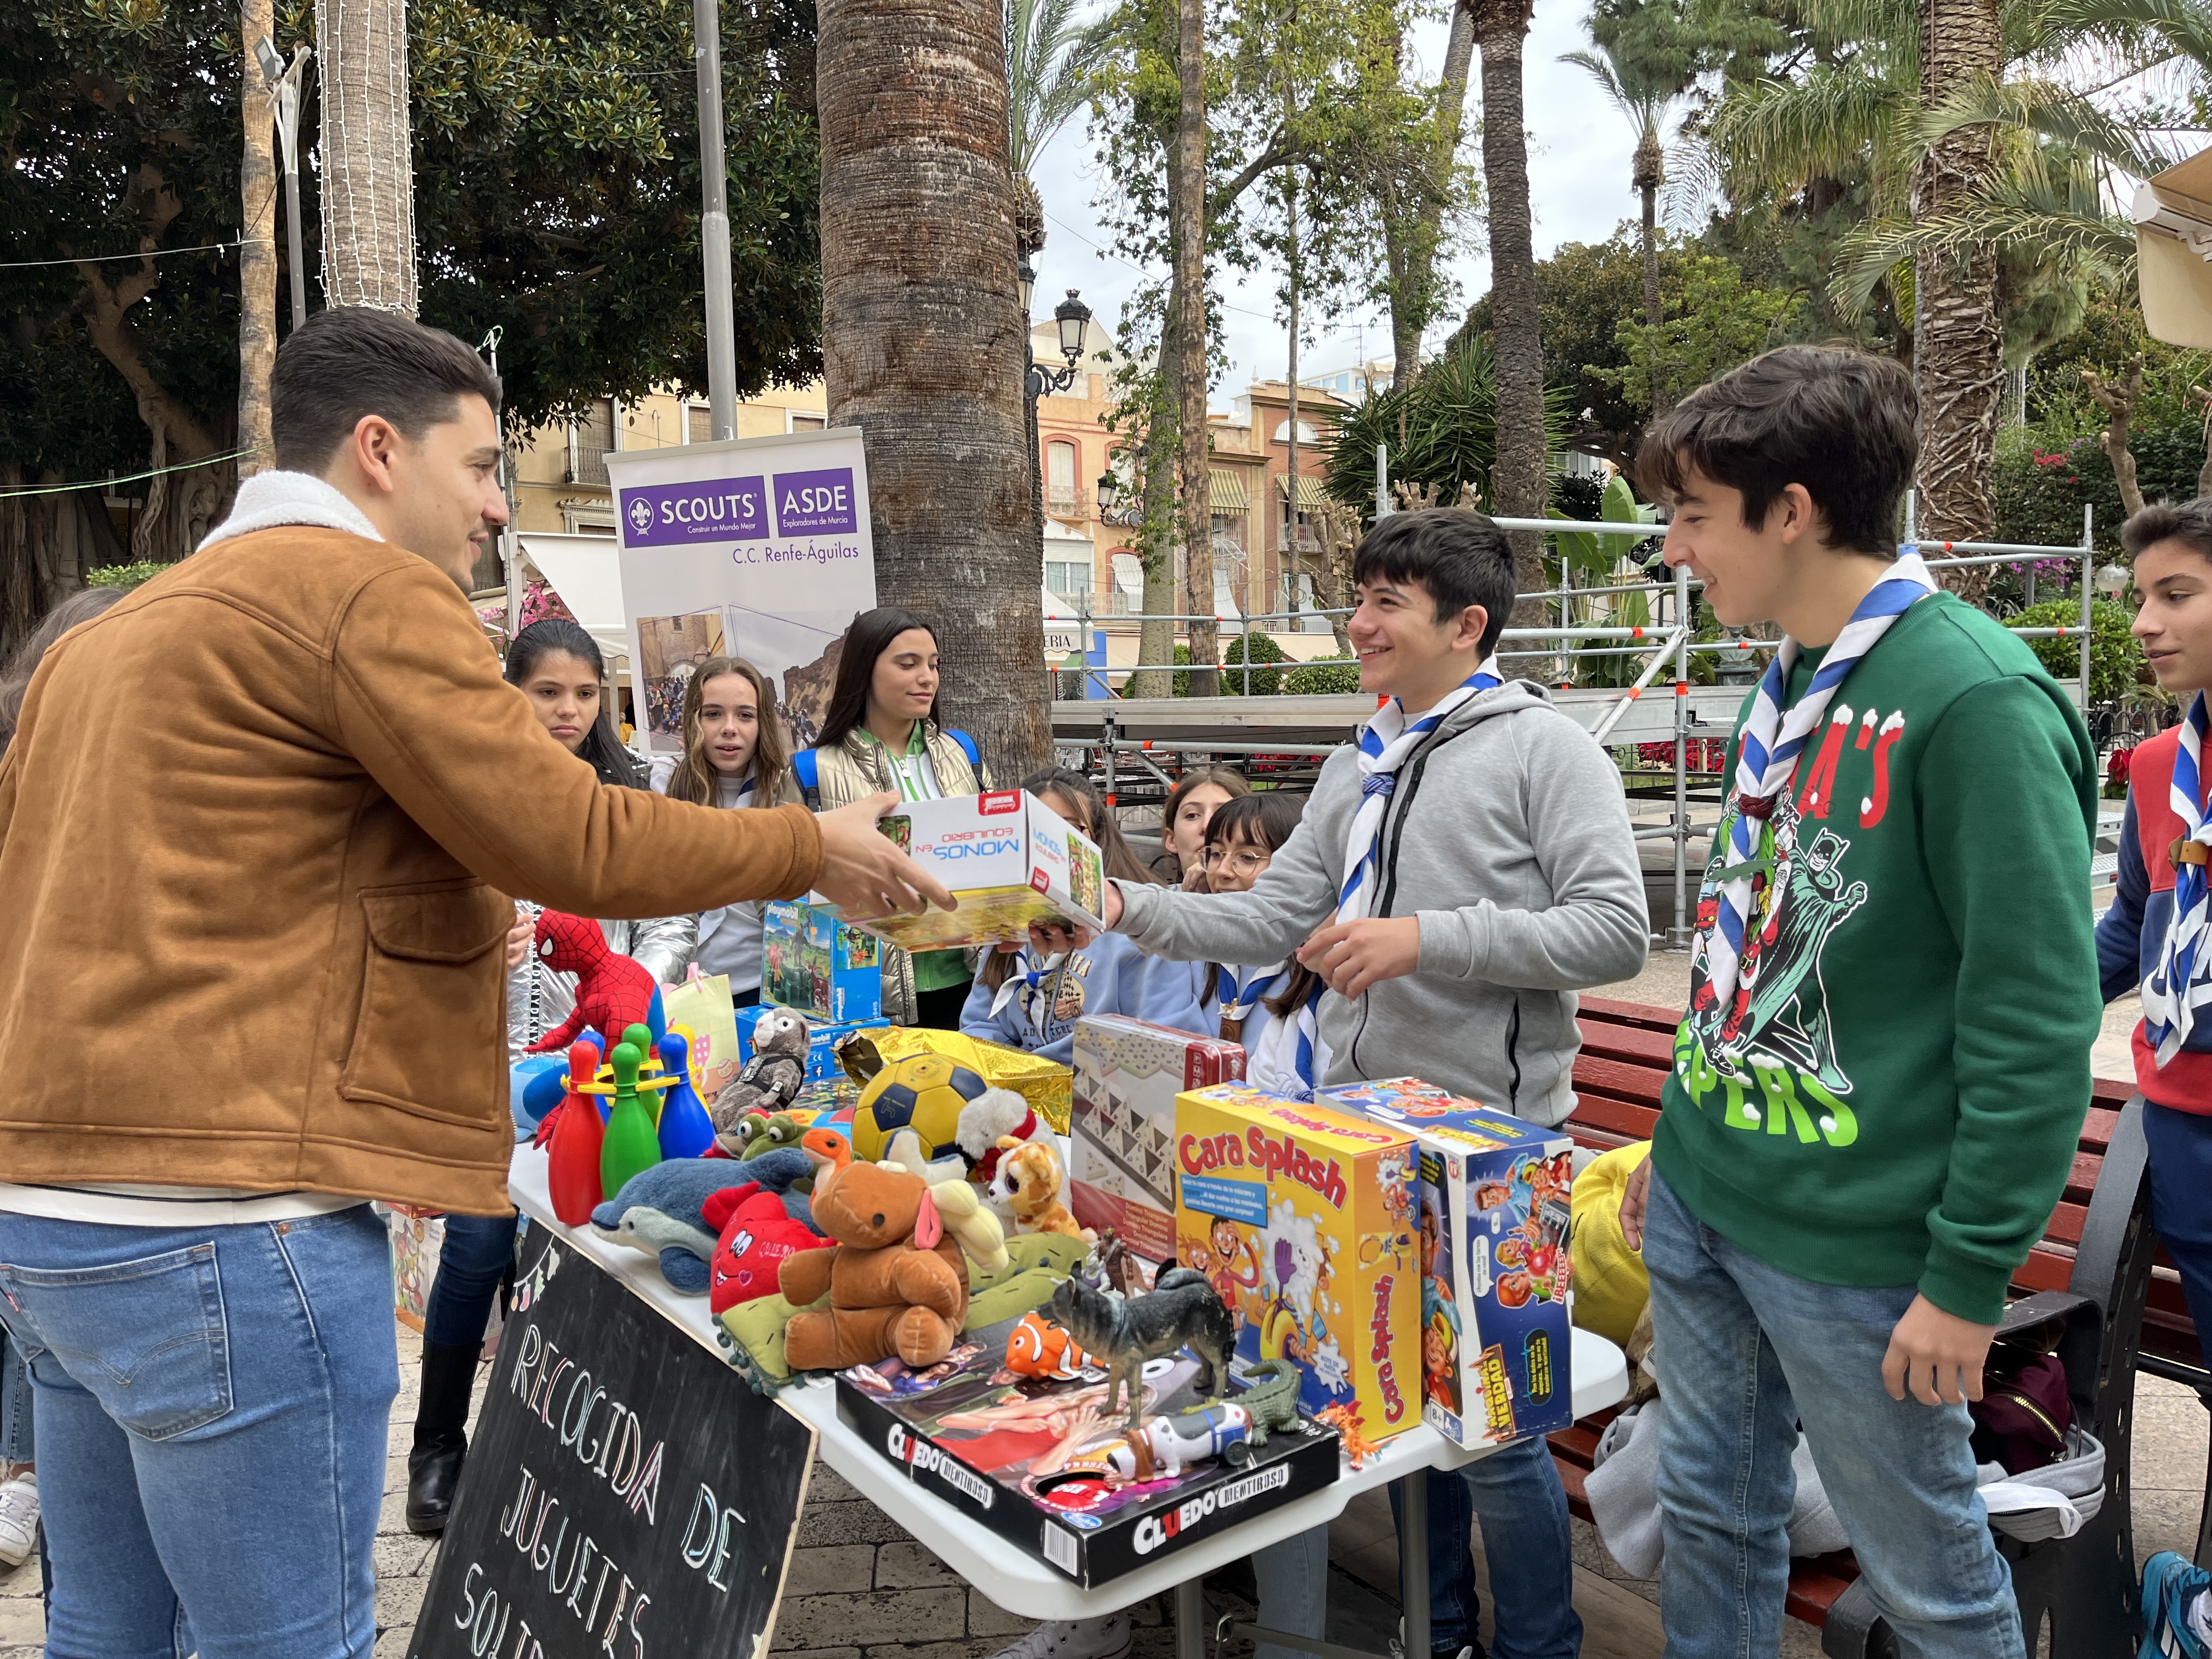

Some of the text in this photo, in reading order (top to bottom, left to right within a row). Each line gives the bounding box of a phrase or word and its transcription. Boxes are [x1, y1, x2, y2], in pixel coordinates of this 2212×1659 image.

[782, 486, 848, 516] ASDE
[687, 525, 710, 534] Construir
[719, 523, 739, 532] Mundo
[740, 522, 757, 532] Mejor
[782, 518, 818, 529] Exploradores
[828, 516, 848, 524] Murcia
[733, 540, 859, 564] C.C. Renfe-Águilas
[942, 827, 1013, 843] EQUILIBRIO
[916, 838, 1019, 861] MONOS EN
[767, 901, 799, 920] playmobil
[1332, 1125, 1394, 1144] Cara
[1178, 1132, 1245, 1176] Cara
[1246, 1125, 1347, 1210] Splash
[759, 1241, 795, 1259] QUIERO
[1370, 1273, 1405, 1425] Cara Splash
[1488, 1358, 1511, 1428] VERDAD
[1432, 1408, 1442, 1423] 8+
[511, 1323, 746, 1593] RECOGIDA DE
[887, 1423, 941, 1472] CLUEDO
[943, 1459, 990, 1504] MENTIROSO
[1132, 1466, 1286, 1556] CLUEDO MENTIROSO
[500, 1464, 652, 1659] JUGUETES
